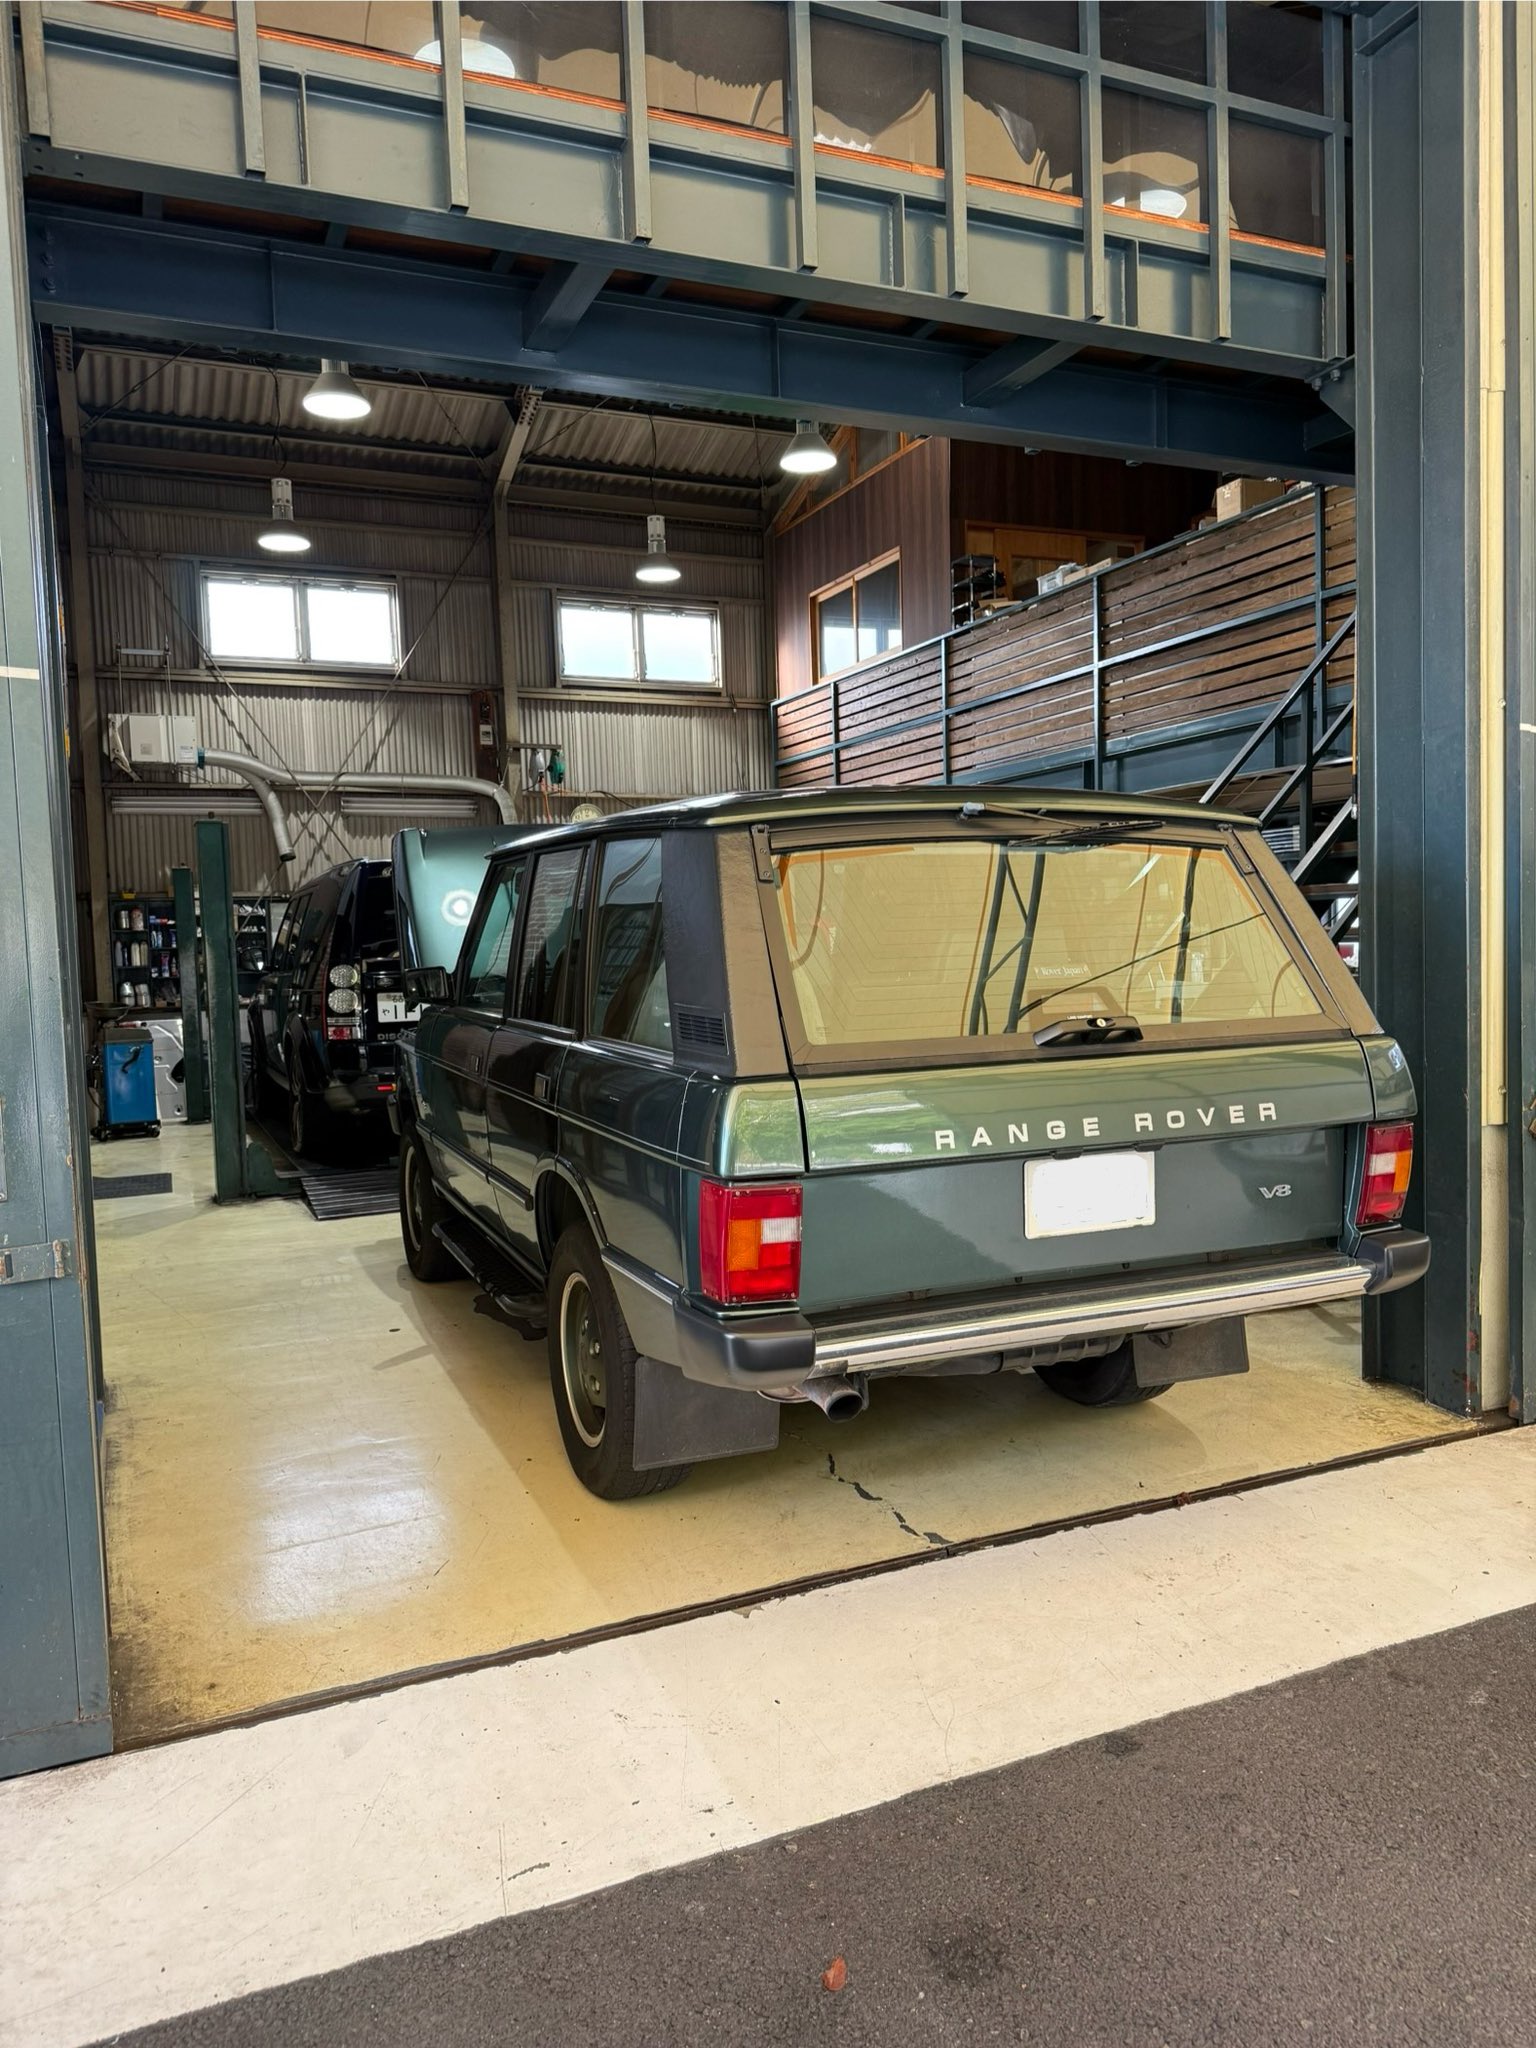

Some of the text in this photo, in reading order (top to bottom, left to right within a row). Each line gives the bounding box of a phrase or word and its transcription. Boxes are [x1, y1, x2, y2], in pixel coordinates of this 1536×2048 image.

[935, 1102, 1277, 1150] RANGE ROVER
[1258, 1184, 1292, 1199] V8
